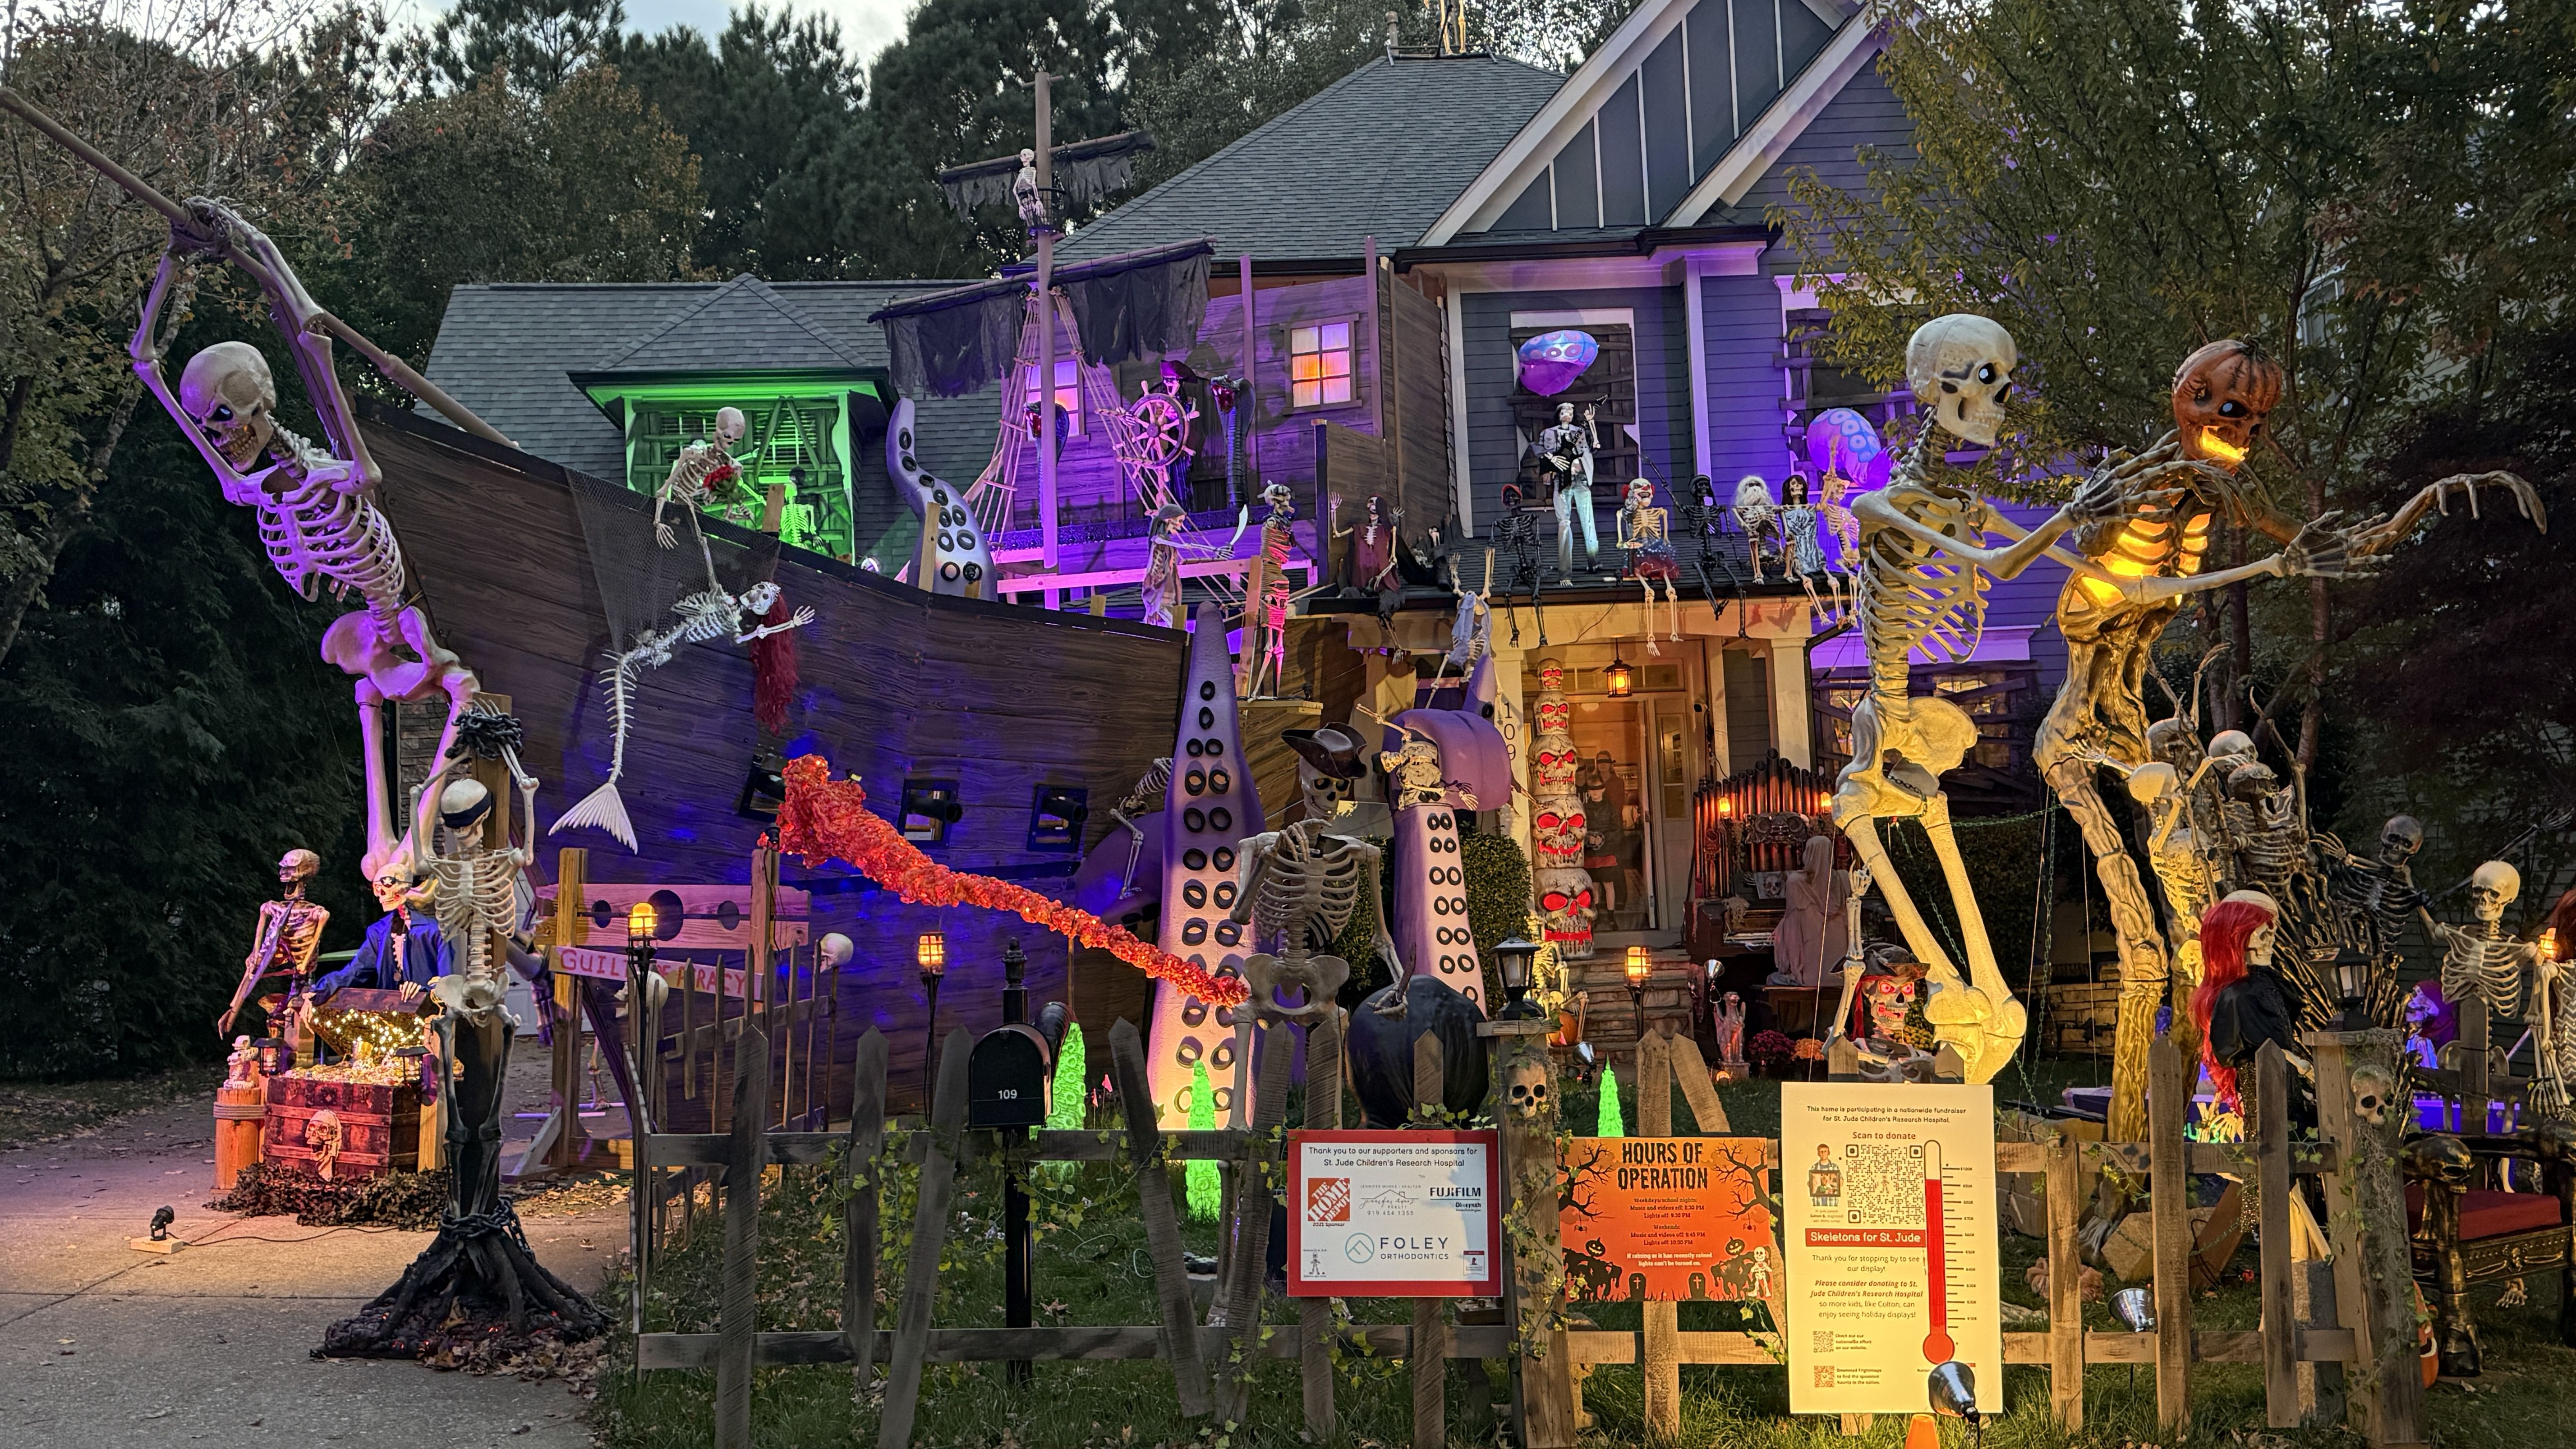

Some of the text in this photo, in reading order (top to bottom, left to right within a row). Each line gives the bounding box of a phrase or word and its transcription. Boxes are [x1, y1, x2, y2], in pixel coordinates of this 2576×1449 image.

[1504, 702, 1516, 761] 109
[561, 949, 637, 978] GUIL
[676, 966, 745, 995] PRACY
[998, 1090, 1017, 1099] 109
[1622, 1142, 1703, 1165] HOURS OF
[1311, 1182, 1329, 1200] THE
[1618, 1168, 1707, 1191] OPERATION
[1308, 1178, 1350, 1221] HOME
[1430, 1187, 1481, 1196] FUJIFILM
[1325, 1194, 1350, 1221] DEPOT
[1380, 1237, 1448, 1249] FOLEY
[1811, 1232, 1921, 1242] Skeletons for St. Jude
